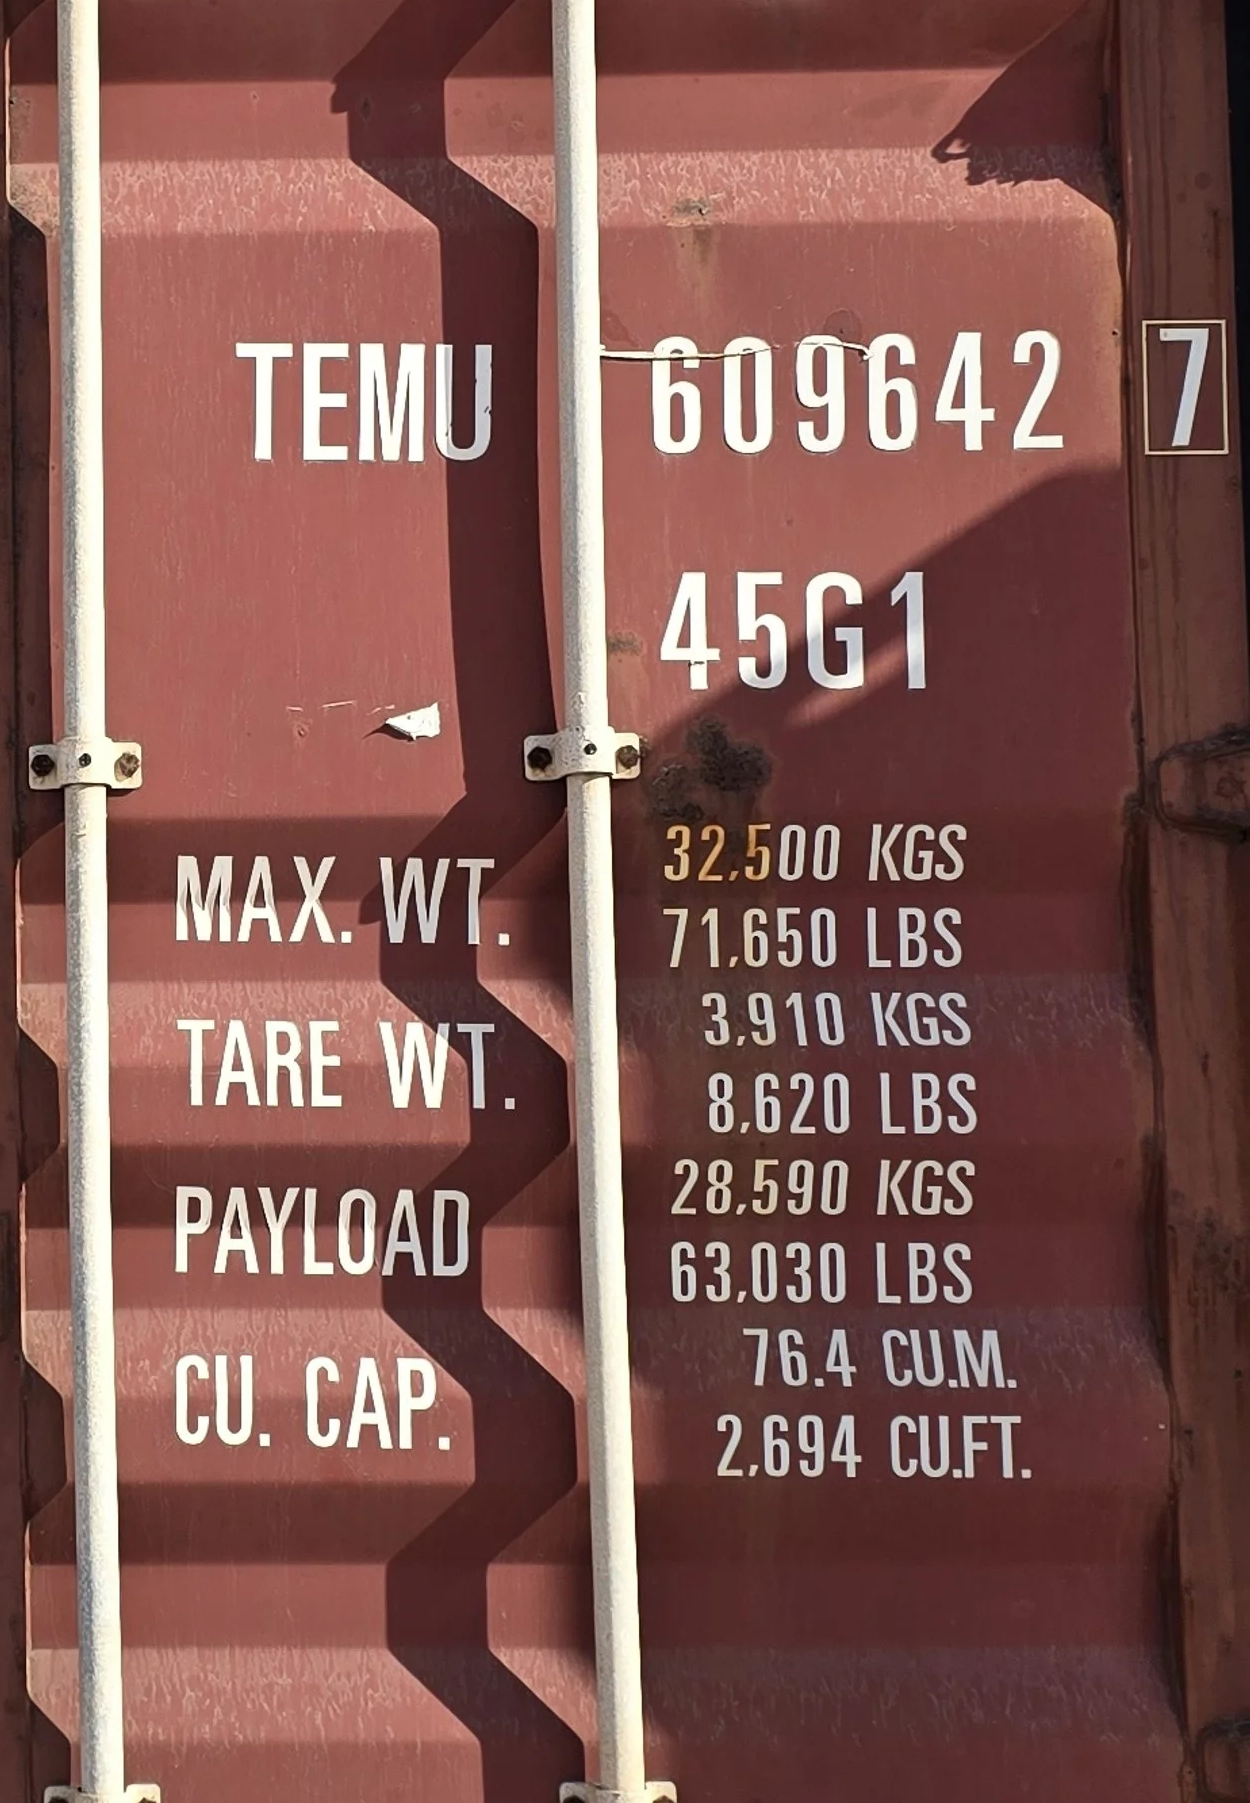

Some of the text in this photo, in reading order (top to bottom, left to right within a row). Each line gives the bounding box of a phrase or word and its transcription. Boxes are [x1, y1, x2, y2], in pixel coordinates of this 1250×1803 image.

[235, 328, 1207, 462] TEMU 609642 7
[660, 571, 927, 690] 45G1
[663, 823, 967, 883] 32,500 KGS
[176, 856, 511, 946] MAX. WT.
[663, 907, 964, 969] 71,650 LBS
[701, 991, 972, 1050] 3,910 KGS
[176, 1019, 516, 1112] TARE WT.
[707, 1072, 977, 1135] 8,620 LBS
[671, 1159, 975, 1218] 28,590 KGS
[175, 1186, 471, 1277] PAYLOAD
[669, 1241, 972, 1305] 63,030 LBS
[744, 1329, 1017, 1390] 76.4 CU.M.
[175, 1354, 451, 1451] CU. CAP.
[716, 1415, 1031, 1479] 2,694 CU.FT.
